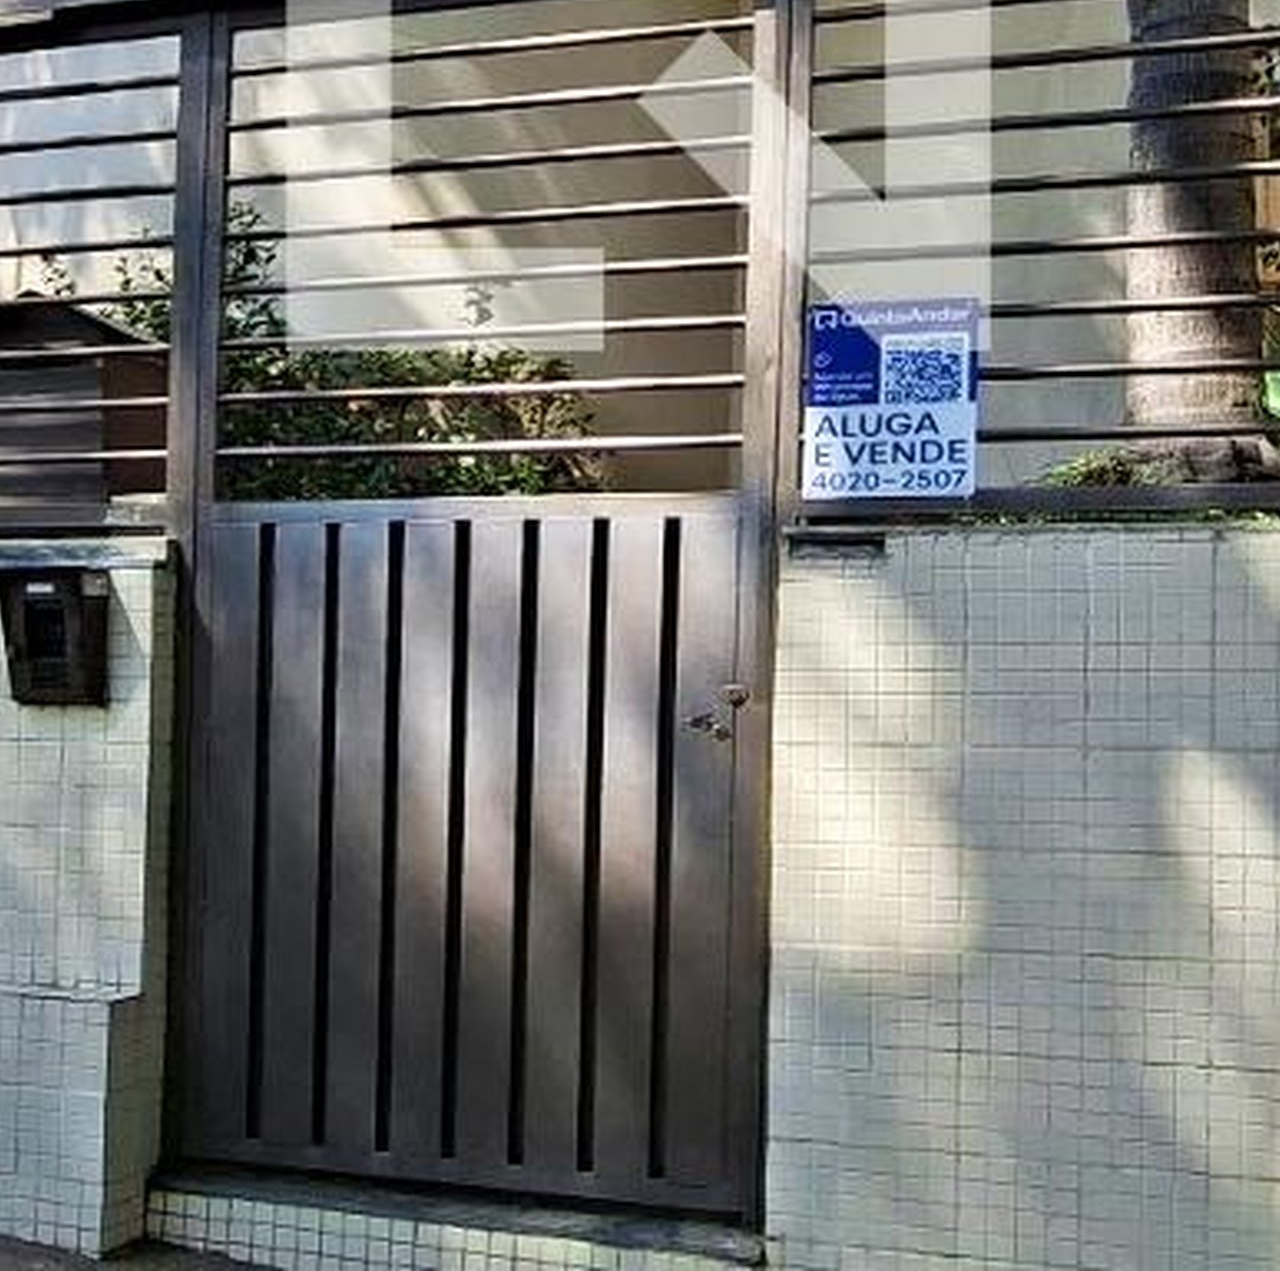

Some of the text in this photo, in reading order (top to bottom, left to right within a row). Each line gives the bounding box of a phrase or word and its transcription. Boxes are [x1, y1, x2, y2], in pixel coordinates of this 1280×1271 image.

[814, 412, 940, 438] ALUGA
[814, 439, 969, 467] E VENDE
[812, 469, 969, 492] 4020-2507
